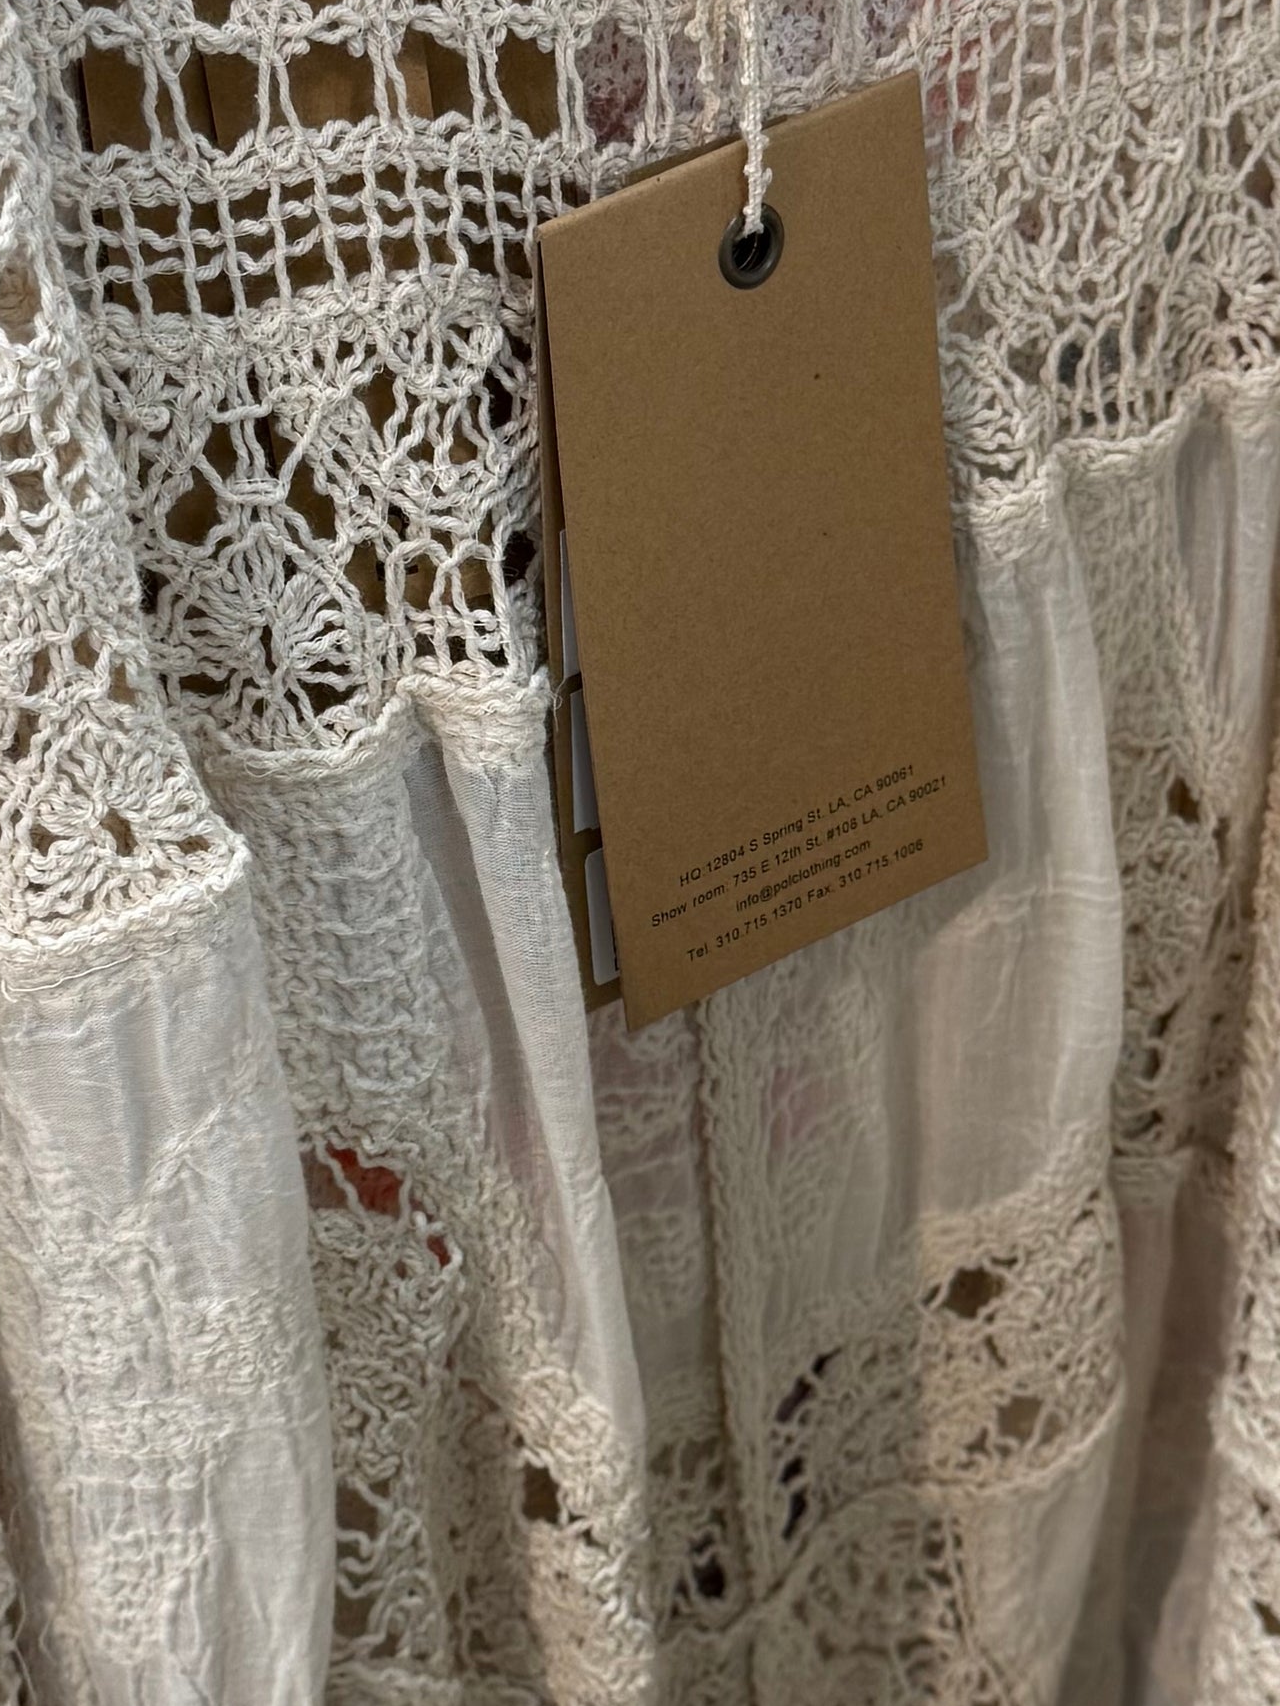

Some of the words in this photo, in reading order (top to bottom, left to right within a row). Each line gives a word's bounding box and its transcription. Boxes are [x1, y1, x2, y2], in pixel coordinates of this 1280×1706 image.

[651, 902, 687, 928] Show
[733, 866, 757, 887] 735
[761, 859, 772, 874] E
[775, 845, 801, 866] 12th
[886, 795, 906, 812] CA
[908, 775, 946, 803] 90021
[749, 838, 759, 852] S
[762, 819, 803, 846] Spring
[853, 784, 873, 802] CA
[876, 764, 914, 791] 90061
[735, 839, 871, 912] info@polclothing.com
